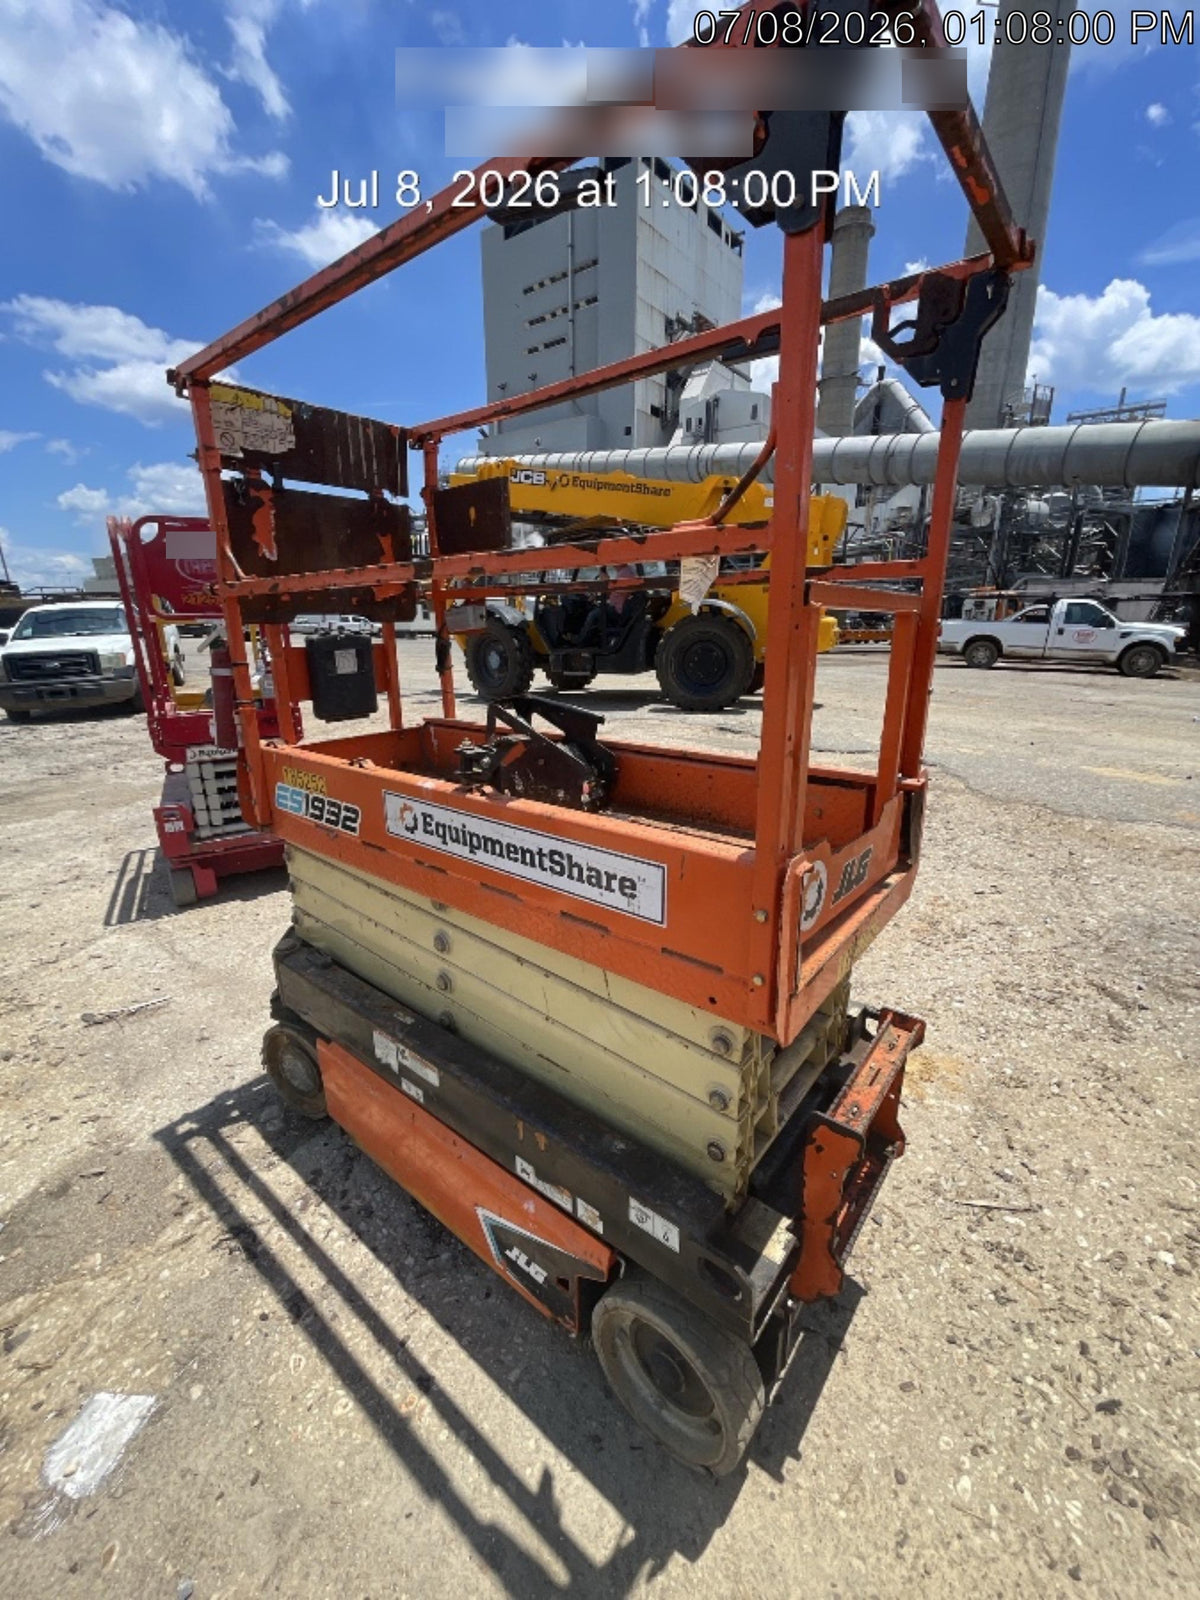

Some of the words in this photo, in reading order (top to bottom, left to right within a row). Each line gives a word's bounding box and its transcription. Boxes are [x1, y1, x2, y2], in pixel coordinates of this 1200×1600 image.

[511, 470, 546, 485] JCB
[572, 476, 671, 496] EquipmentShare
[420, 811, 638, 900] EquipmentShare
[504, 1246, 548, 1285] JLG
